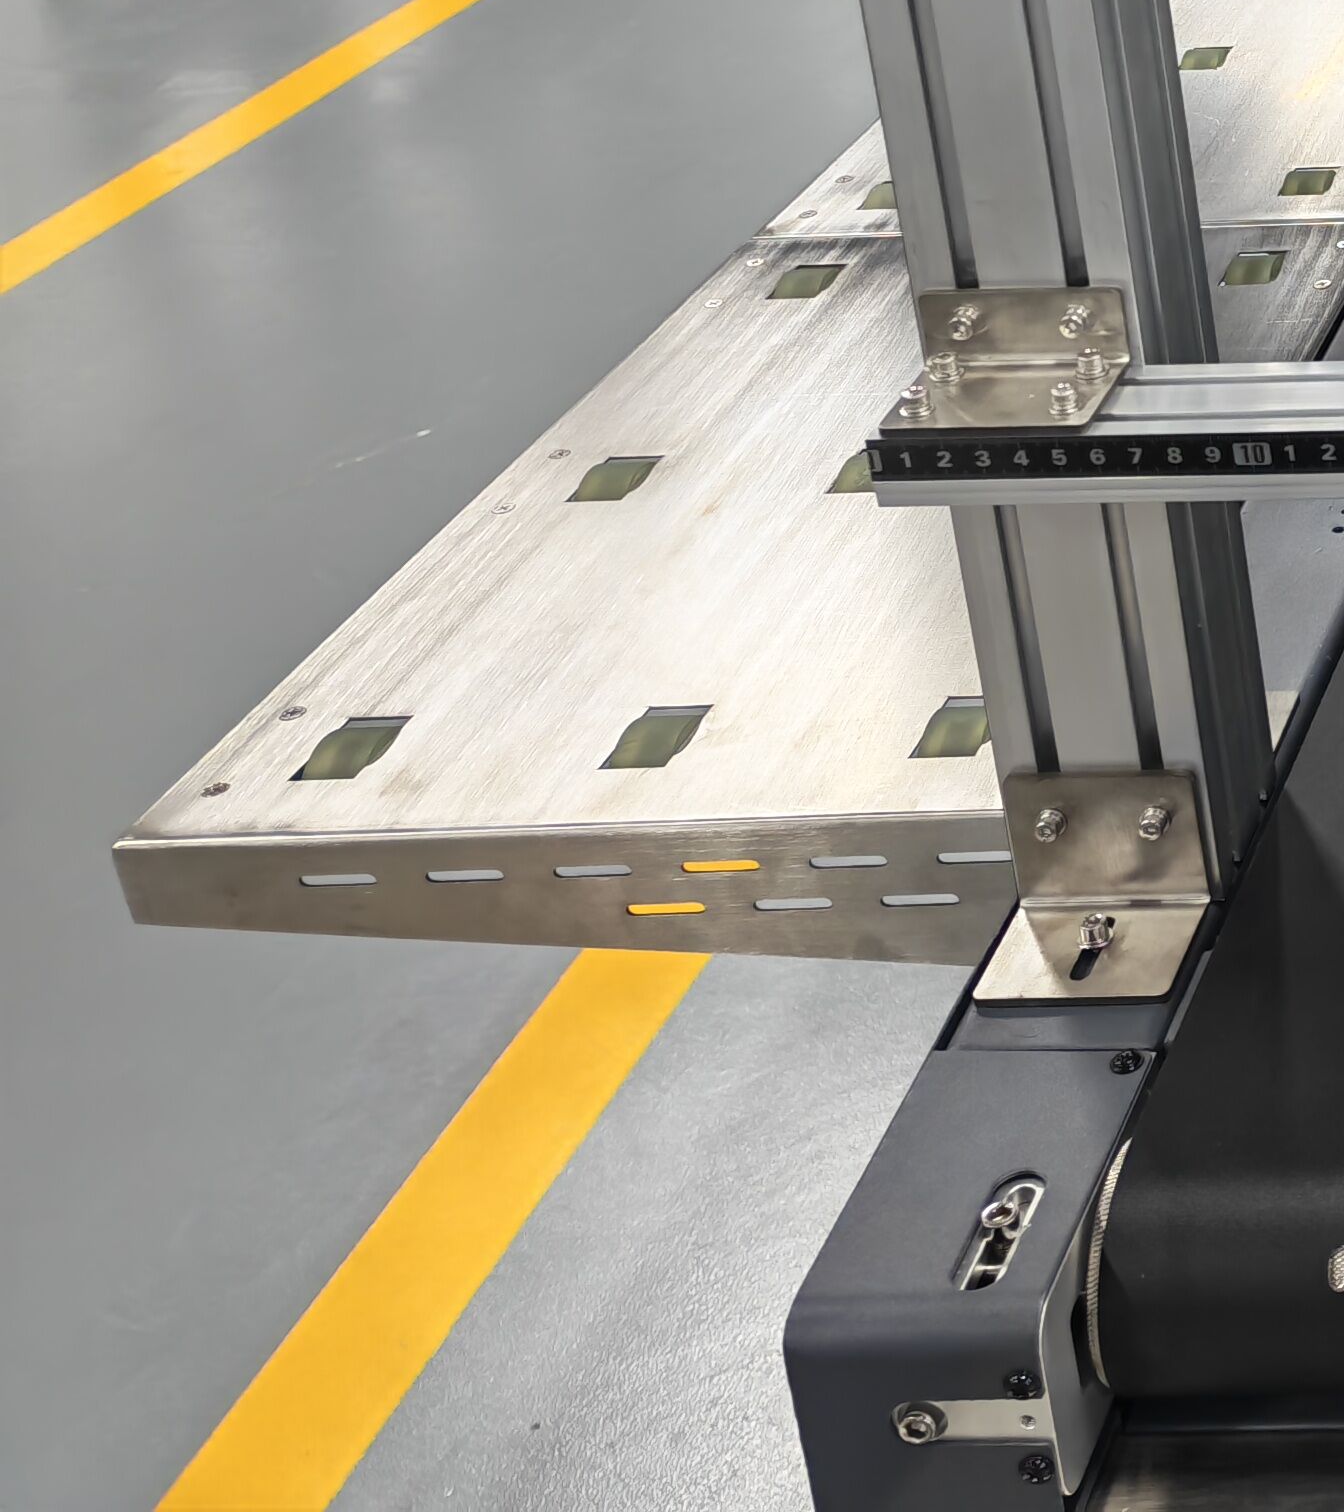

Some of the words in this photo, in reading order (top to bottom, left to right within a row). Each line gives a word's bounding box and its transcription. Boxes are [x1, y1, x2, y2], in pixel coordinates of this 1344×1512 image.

[899, 451, 912, 468] 1
[936, 450, 954, 468] 2
[974, 450, 992, 467] 3
[1013, 449, 1030, 466] 4
[1051, 448, 1068, 466] 5
[1089, 448, 1106, 465] 6
[1127, 447, 1143, 465] 7
[1166, 446, 1183, 464] 8
[1204, 446, 1221, 463] 9
[1240, 445, 1265, 463] 10
[1283, 444, 1296, 462] 1
[1320, 443, 1337, 461] 2
